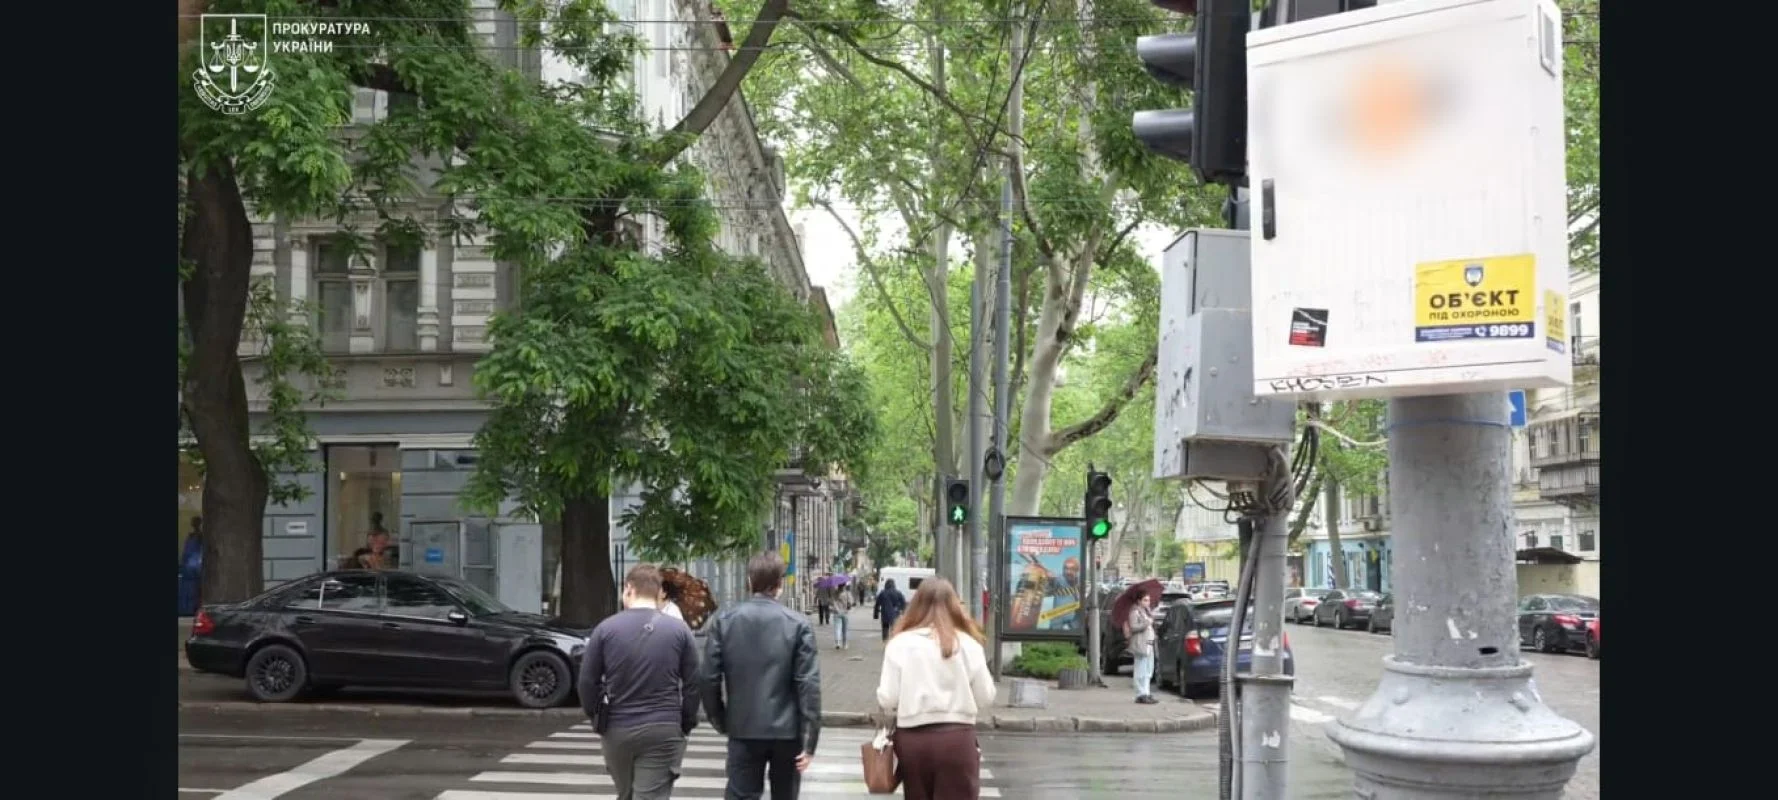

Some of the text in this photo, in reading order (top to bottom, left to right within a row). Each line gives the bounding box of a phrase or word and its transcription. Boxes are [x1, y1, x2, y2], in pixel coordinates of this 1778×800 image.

[1429, 290, 1520, 309] ОБ'ЄКТ
[1429, 308, 1520, 320] ПІД ОХОРОНОЮ
[1489, 324, 1529, 337] 9899
